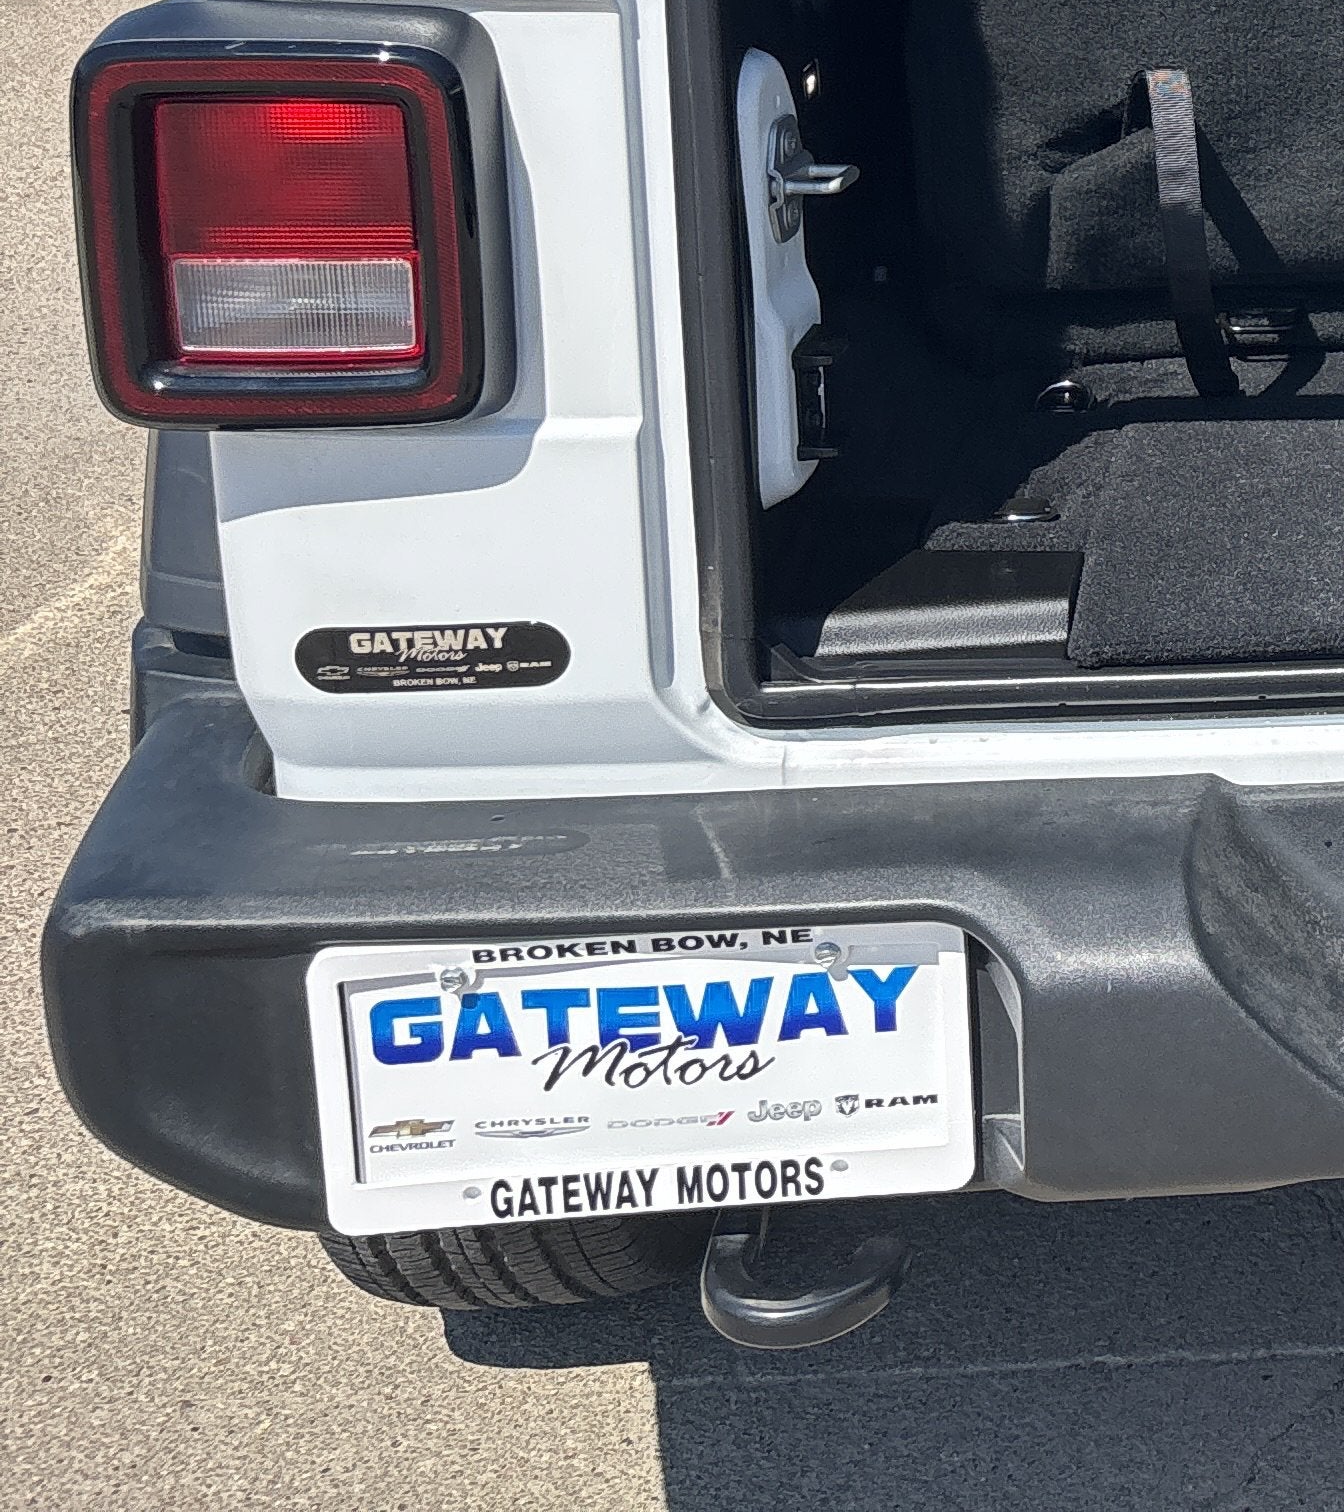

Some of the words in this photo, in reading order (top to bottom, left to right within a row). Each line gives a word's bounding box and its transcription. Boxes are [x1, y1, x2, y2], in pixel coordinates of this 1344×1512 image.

[349, 626, 509, 656] GATEWAY
[395, 646, 468, 663] Motors
[393, 678, 434, 687] BROKEN
[475, 663, 502, 673] Jeep
[472, 937, 636, 964] BROKEN
[652, 929, 748, 955] BOW,
[763, 926, 813, 946] NE
[370, 965, 920, 1066] GATEWAY
[532, 1034, 777, 1092] Motors
[474, 1115, 591, 1130] CHRYSLER
[606, 1115, 720, 1129] DODGE
[747, 1098, 823, 1123] Jeep
[864, 1093, 939, 1109] RAM
[369, 1138, 456, 1154] CHEVROLET
[490, 1168, 657, 1221] GATEWAY
[677, 1158, 825, 1204] MOTORS
